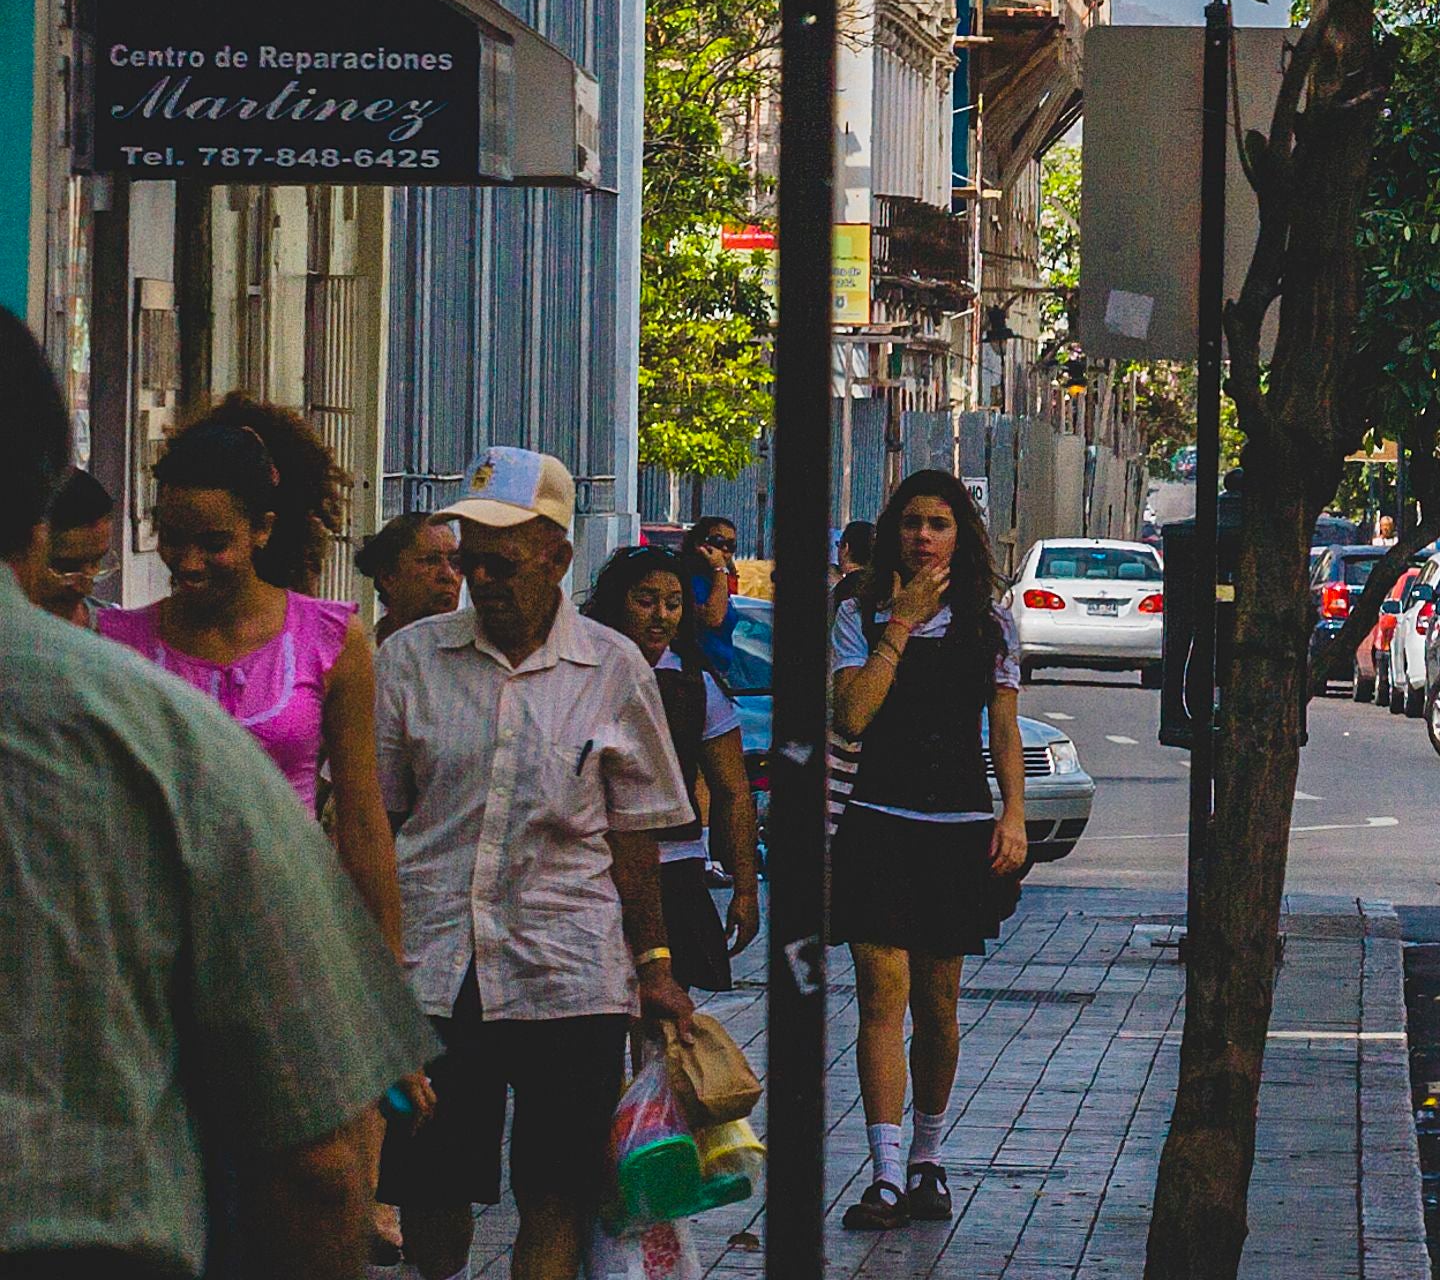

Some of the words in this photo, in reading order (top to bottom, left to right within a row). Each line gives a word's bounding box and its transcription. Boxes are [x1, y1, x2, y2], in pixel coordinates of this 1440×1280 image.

[110, 44, 204, 68] Centro
[215, 46, 248, 68] de
[260, 46, 453, 74] Reparaciones
[111, 75, 448, 143] Martinez
[121, 146, 185, 167] Tel.
[198, 147, 441, 169] 787-848-6425
